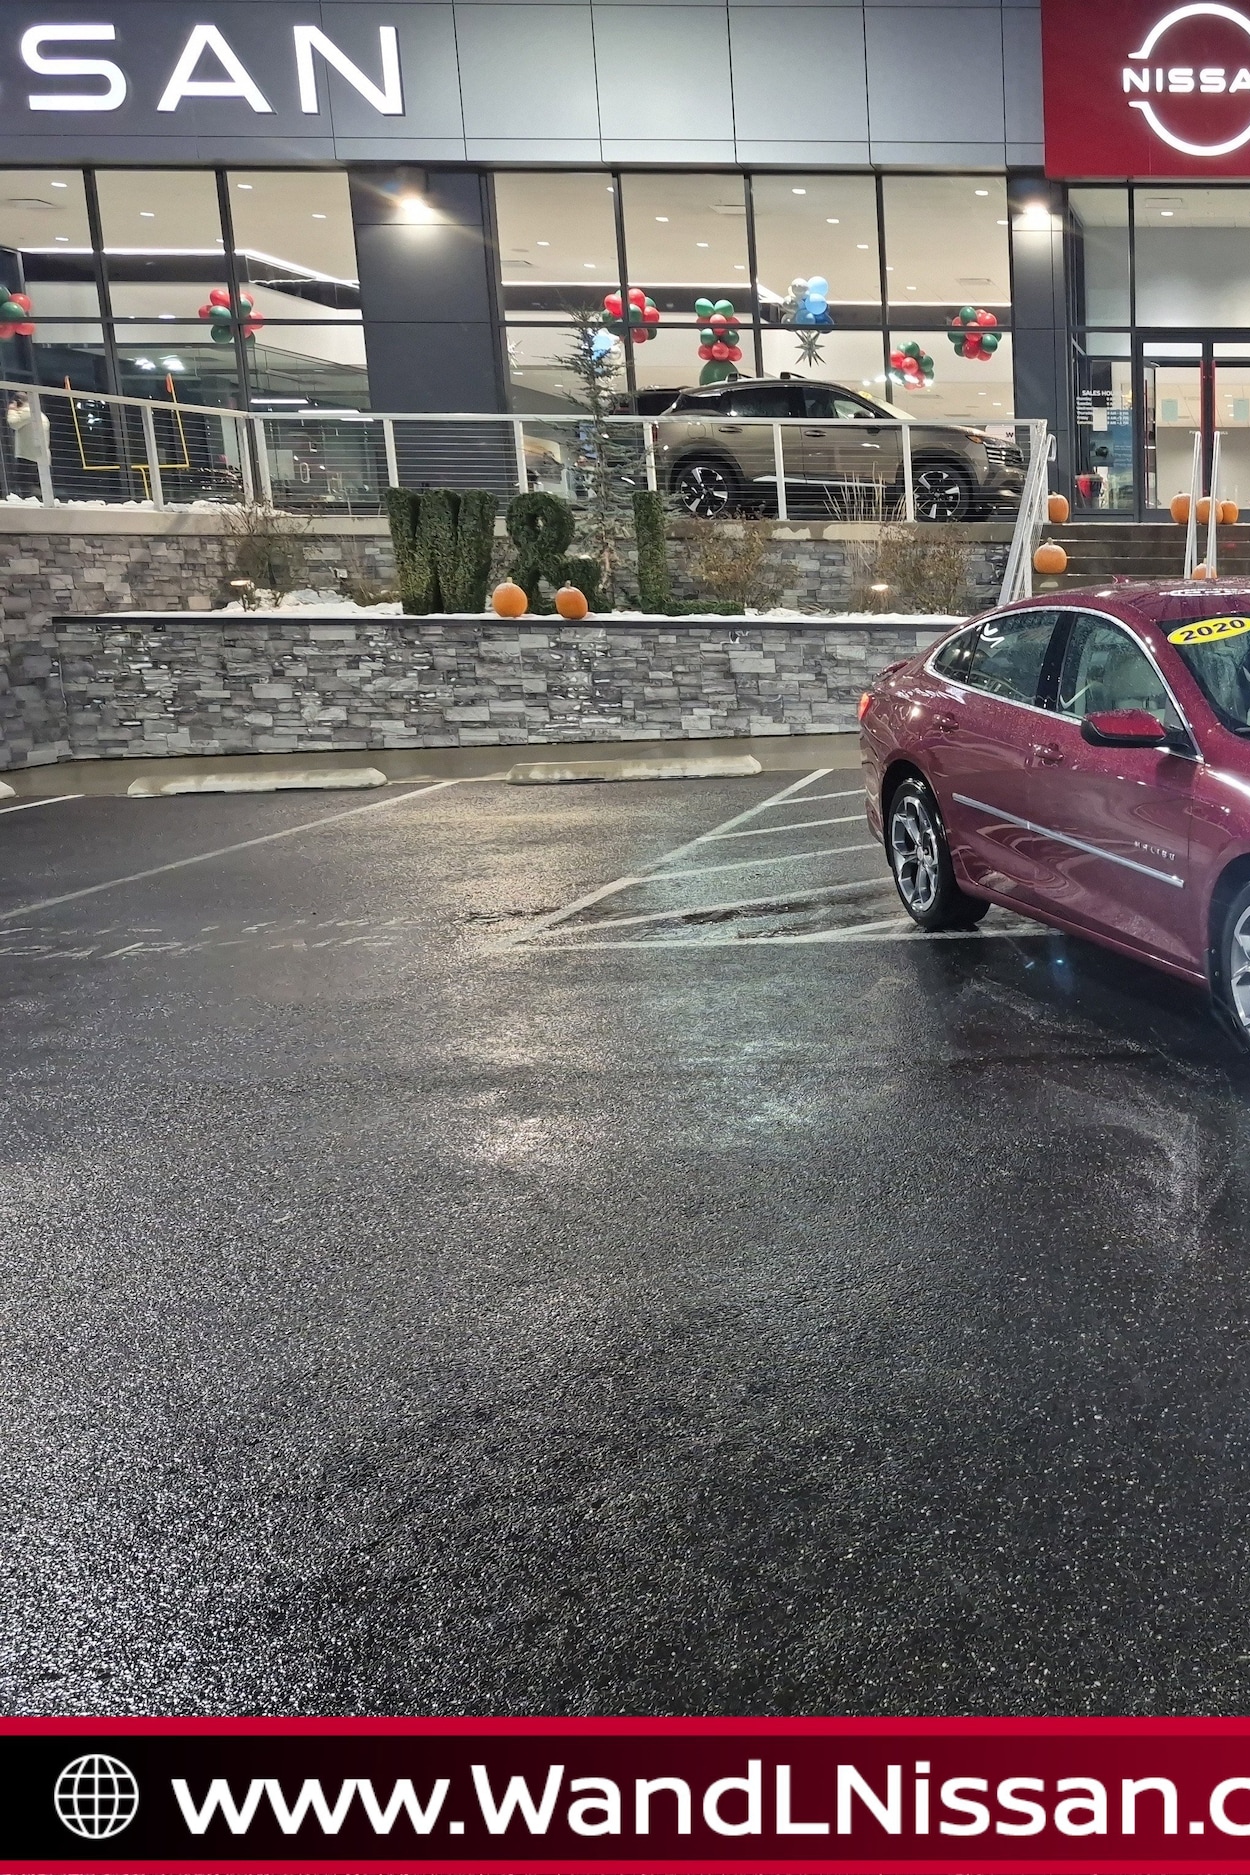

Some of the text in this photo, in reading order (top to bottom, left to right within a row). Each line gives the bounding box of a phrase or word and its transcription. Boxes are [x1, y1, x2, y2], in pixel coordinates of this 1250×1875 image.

[20, 24, 404, 115] SAN
[1081, 389, 1101, 397] SALES
[1180, 619, 1245, 641] 2020
[1134, 840, 1176, 861] MALIBU
